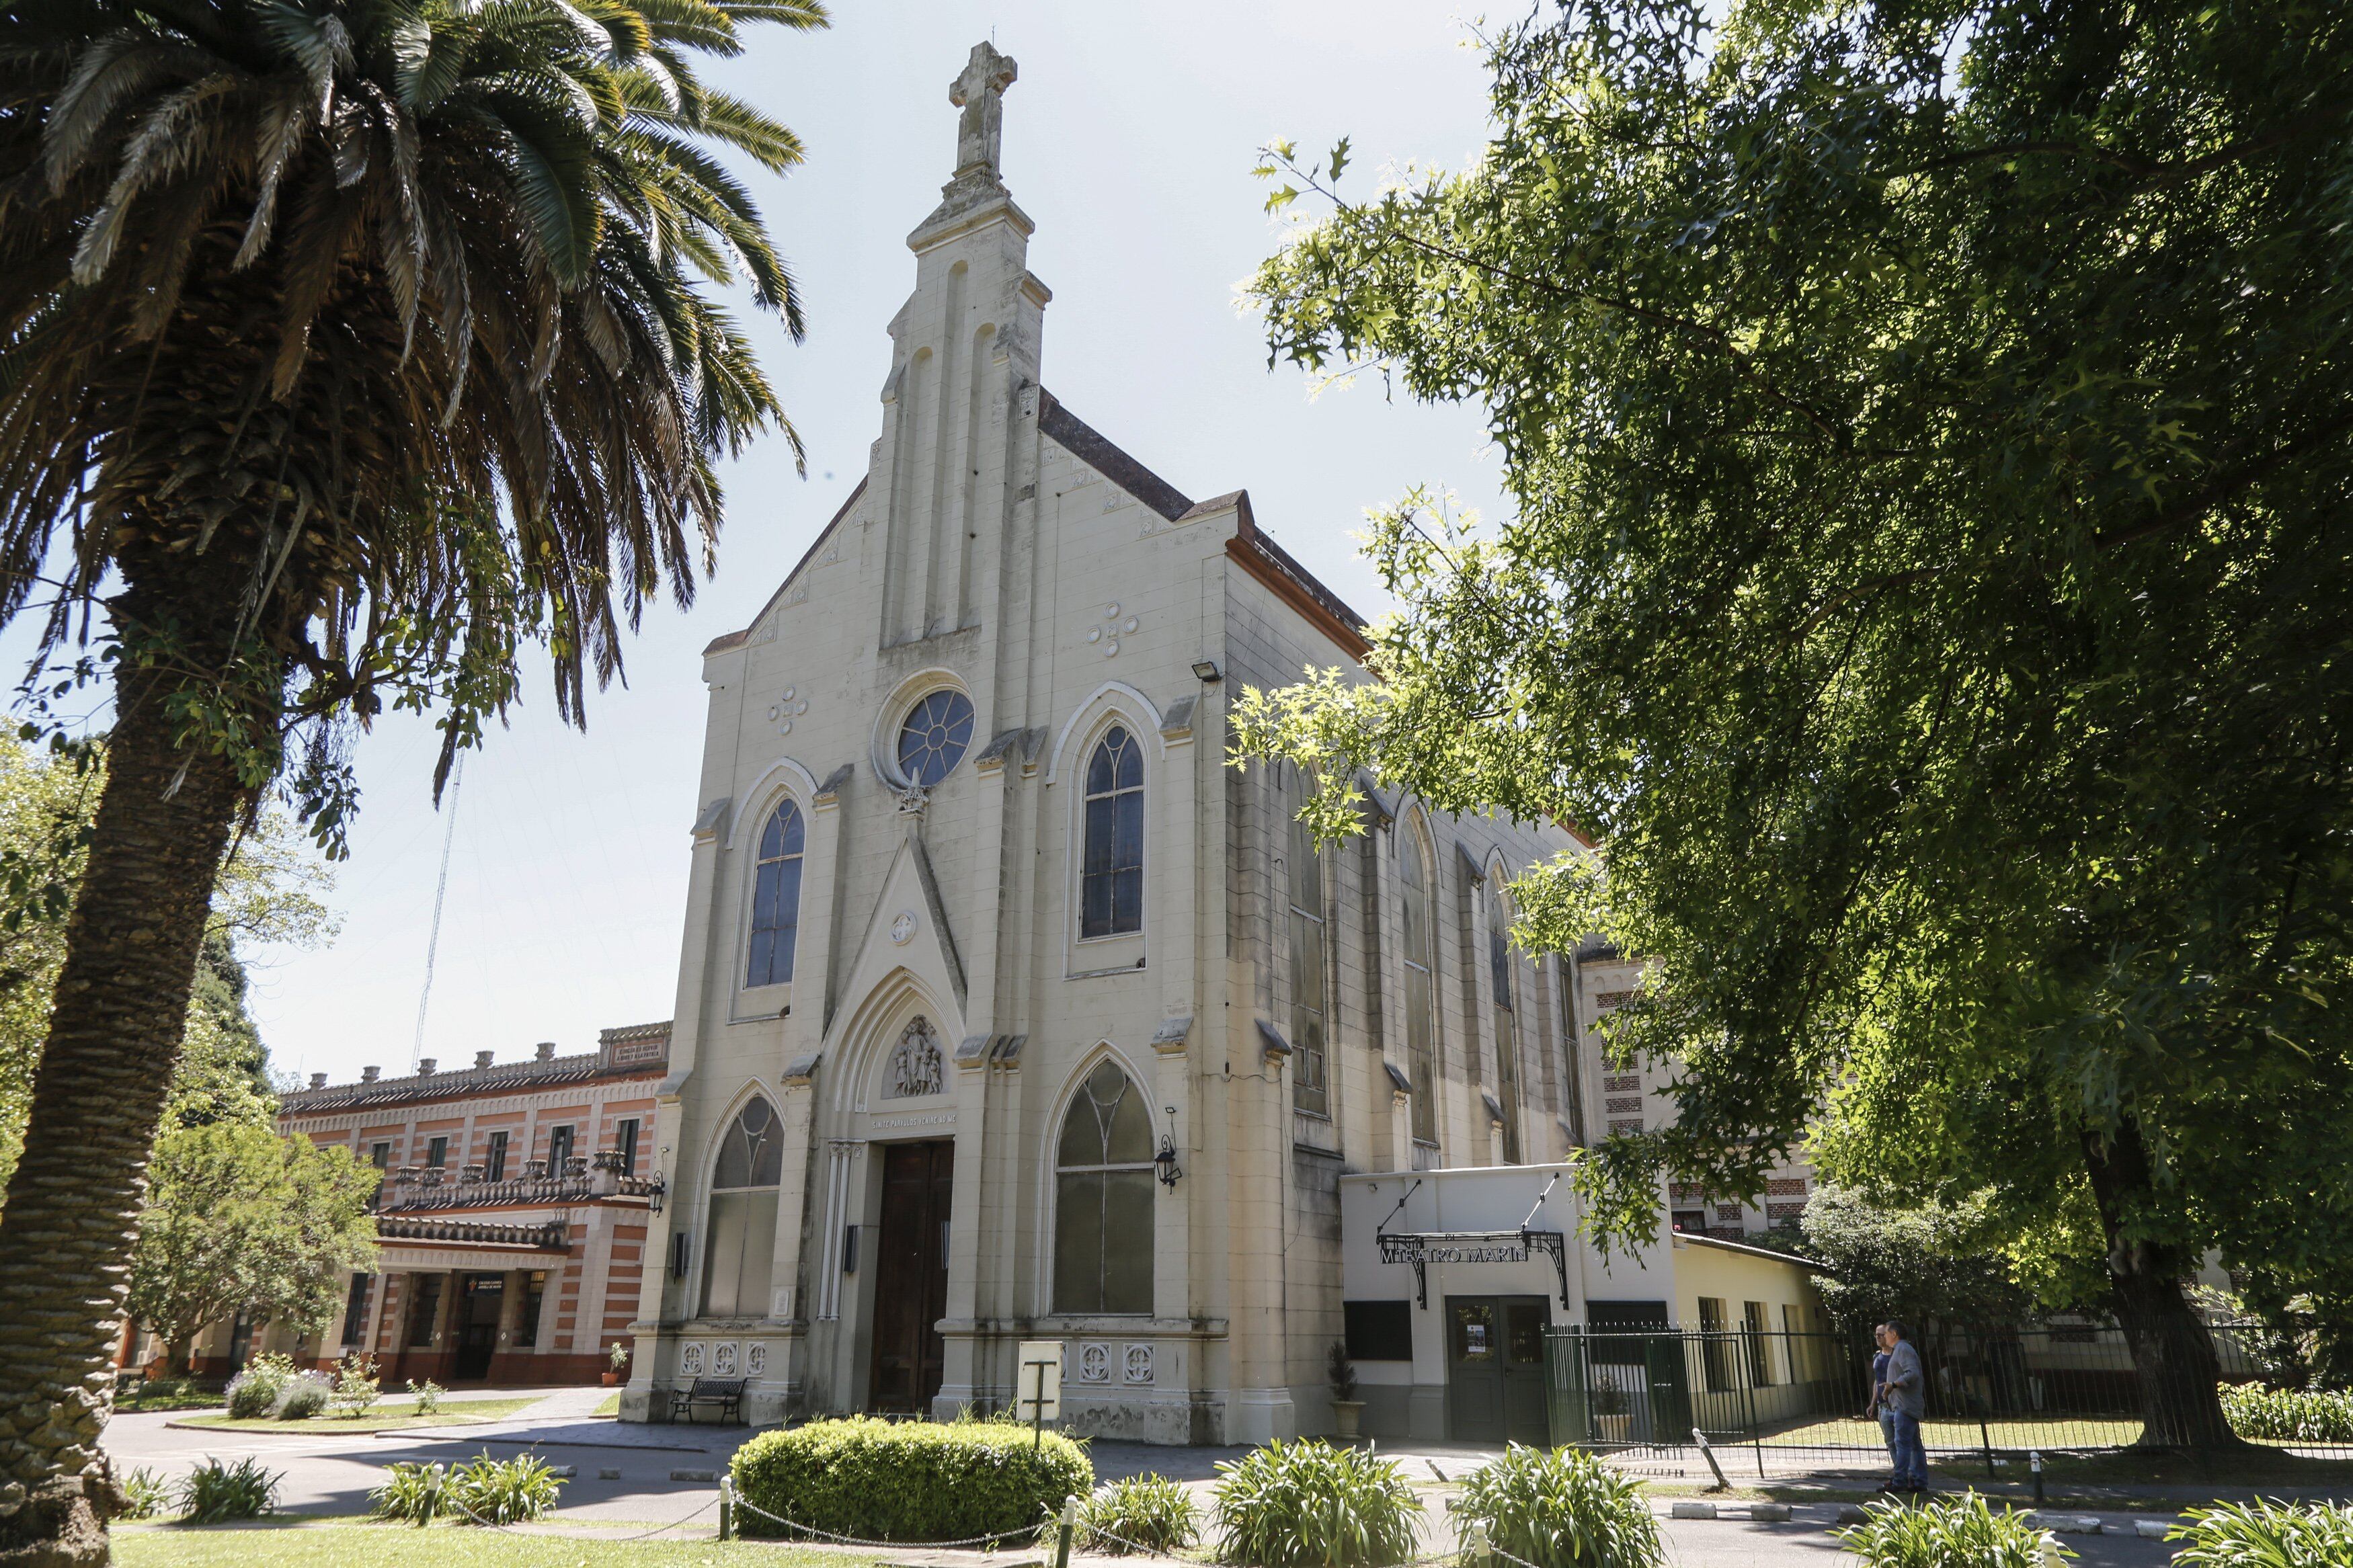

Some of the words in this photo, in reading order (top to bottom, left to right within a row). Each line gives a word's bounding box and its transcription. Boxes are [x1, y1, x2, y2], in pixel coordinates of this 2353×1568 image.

[872, 1120, 889, 1129] SINITE
[891, 1118, 917, 1127] PARVULOS
[918, 1115, 937, 1125] VENIRE
[948, 1114, 957, 1123] ME
[1396, 1247, 1460, 1264] TEATRO
[1467, 1245, 1527, 1263] MARIN
